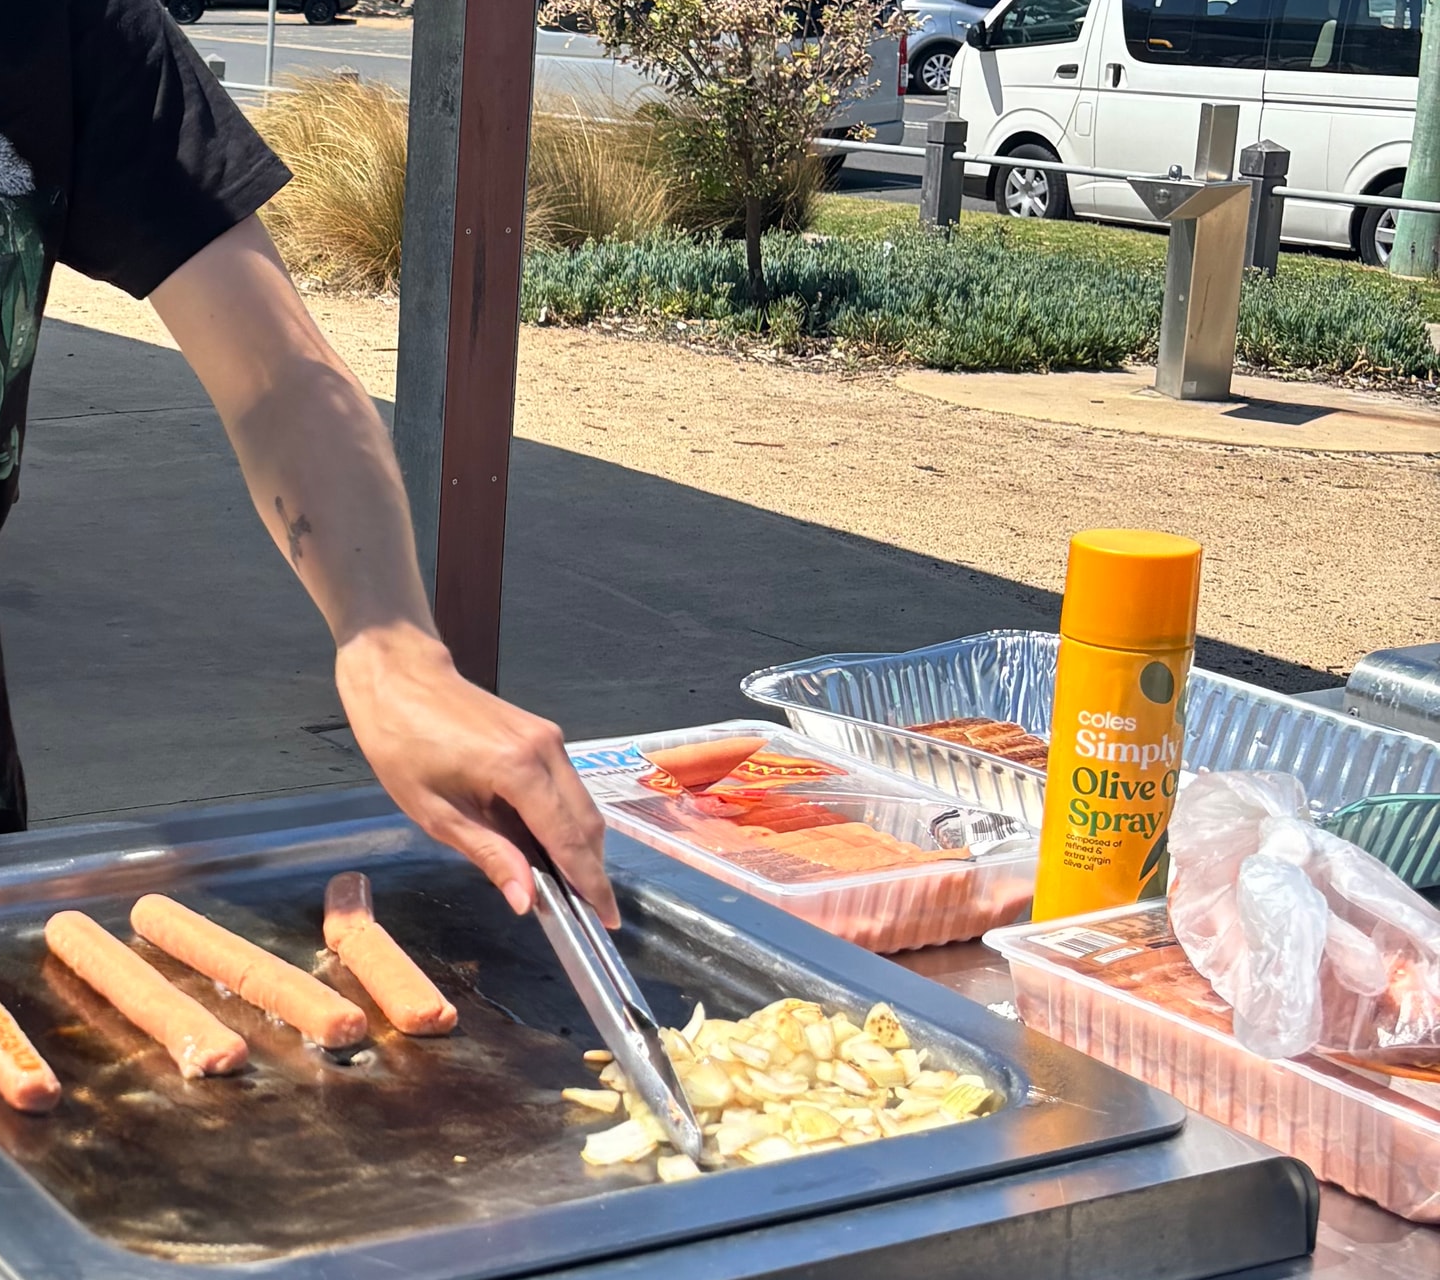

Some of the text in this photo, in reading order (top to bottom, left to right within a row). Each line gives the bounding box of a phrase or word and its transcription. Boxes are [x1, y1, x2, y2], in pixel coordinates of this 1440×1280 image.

[1077, 710, 1137, 731] coles
[1074, 729, 1180, 771] Simply
[1071, 766, 1157, 801] Olive
[1068, 797, 1164, 840] Spray
[1064, 841, 1103, 855] refined &
[1065, 833, 1123, 848] composed of
[1063, 858, 1095, 871] olive oil
[1064, 850, 1112, 866] extra virgin
